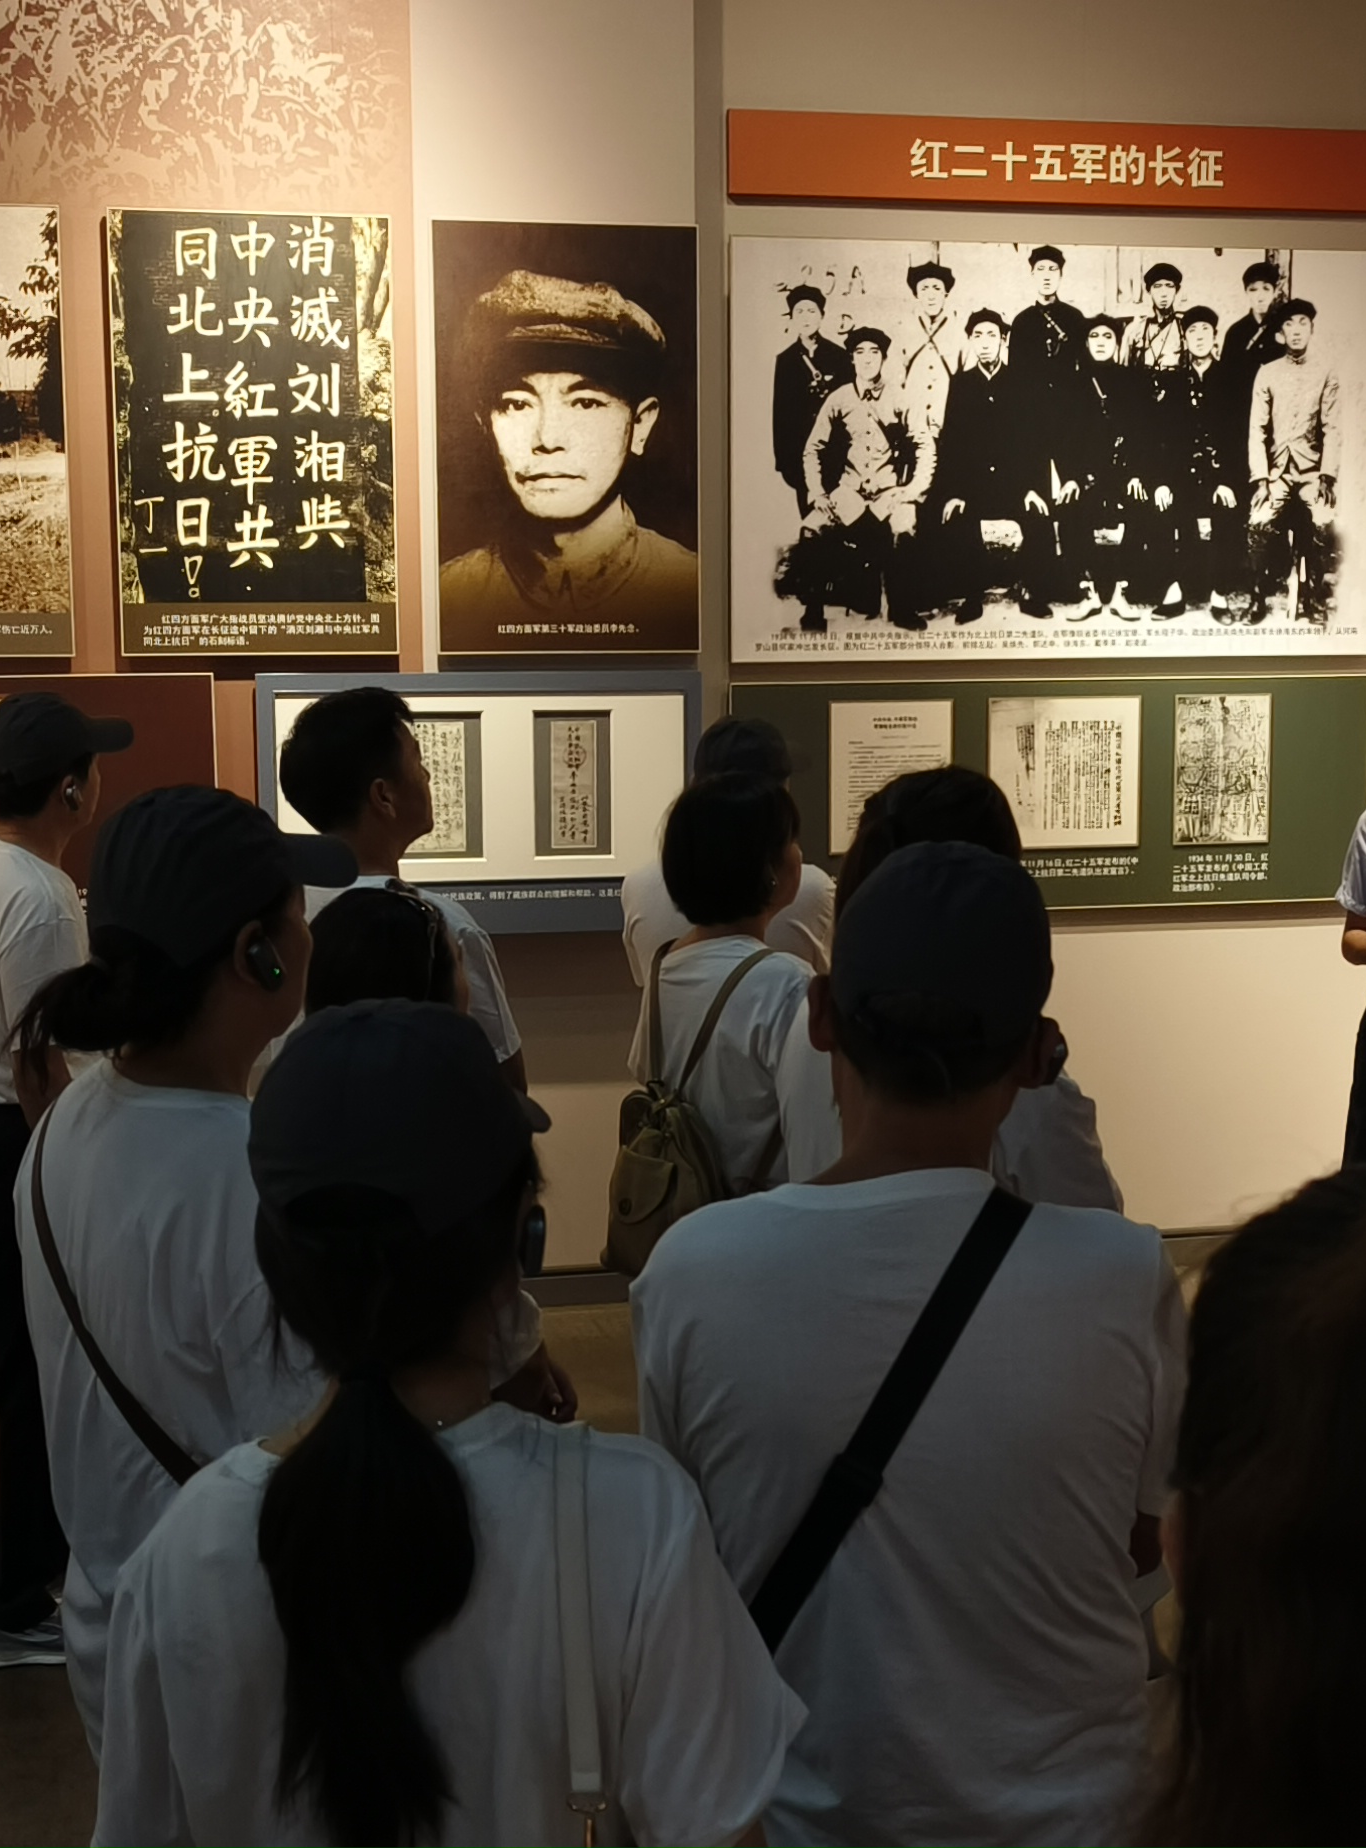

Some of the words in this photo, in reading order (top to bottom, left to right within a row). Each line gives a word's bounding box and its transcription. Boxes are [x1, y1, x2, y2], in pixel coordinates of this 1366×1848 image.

[909, 137, 1225, 188] 红二十五军的长征
